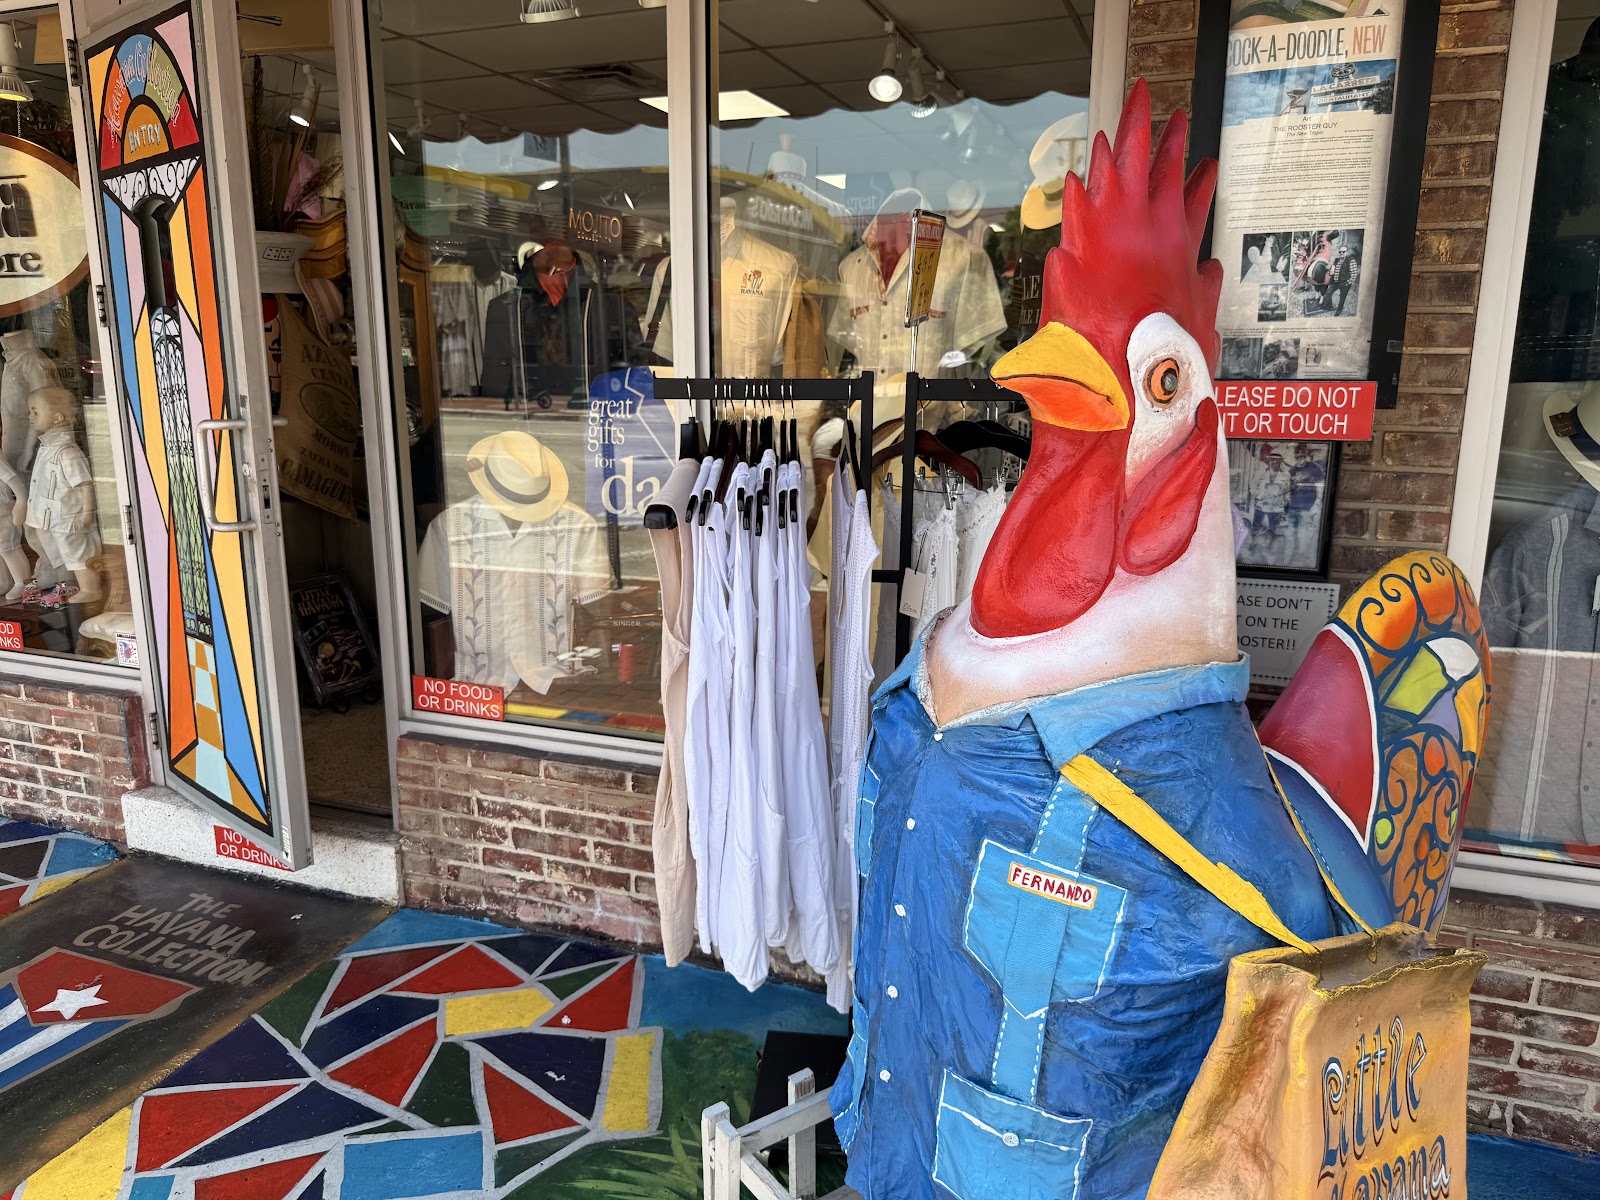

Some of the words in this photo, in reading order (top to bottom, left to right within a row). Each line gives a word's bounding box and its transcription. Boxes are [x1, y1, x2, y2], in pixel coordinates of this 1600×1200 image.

[1352, 25, 1387, 55] NEW
[128, 122, 161, 153] ENTRY
[1288, 124, 1321, 132] ROOSTER
[1322, 122, 1338, 130] GUY
[569, 207, 621, 238] MOJITO
[740, 289, 765, 297] HAVANA
[1215, 386, 1277, 408] LEASE
[1282, 386, 1312, 408] DO
[1318, 387, 1361, 409] NOT
[589, 398, 633, 425] great
[1221, 412, 1239, 433] IT
[1243, 412, 1272, 434] OR
[1278, 413, 1348, 434] TOUCH
[587, 418, 625, 452] gifts
[594, 453, 616, 468] for
[601, 455, 660, 516] da
[297, 594, 345, 617] HAVANA
[299, 586, 332, 602] LITTLE
[1237, 595, 1262, 608] ASE
[1266, 597, 1312, 611] DON'T
[0, 622, 14, 635] OD
[1245, 616, 1267, 628] ON
[1272, 617, 1299, 631] THE
[0, 636, 21, 649] NKS
[1237, 635, 1296, 650] OSTER!!
[424, 679, 446, 694] NO
[450, 683, 493, 700] FOOD
[418, 694, 440, 709] OR
[444, 698, 500, 718] DRINKS
[223, 829, 243, 844] NO
[220, 842, 239, 857] OR
[1011, 866, 1093, 904] FERNANDO
[177, 892, 243, 919] THE
[108, 904, 257, 955] HAVANA
[72, 924, 274, 988] COLLECTION
[1319, 1015, 1428, 1180] Little
[1331, 1134, 1452, 1200] vana
